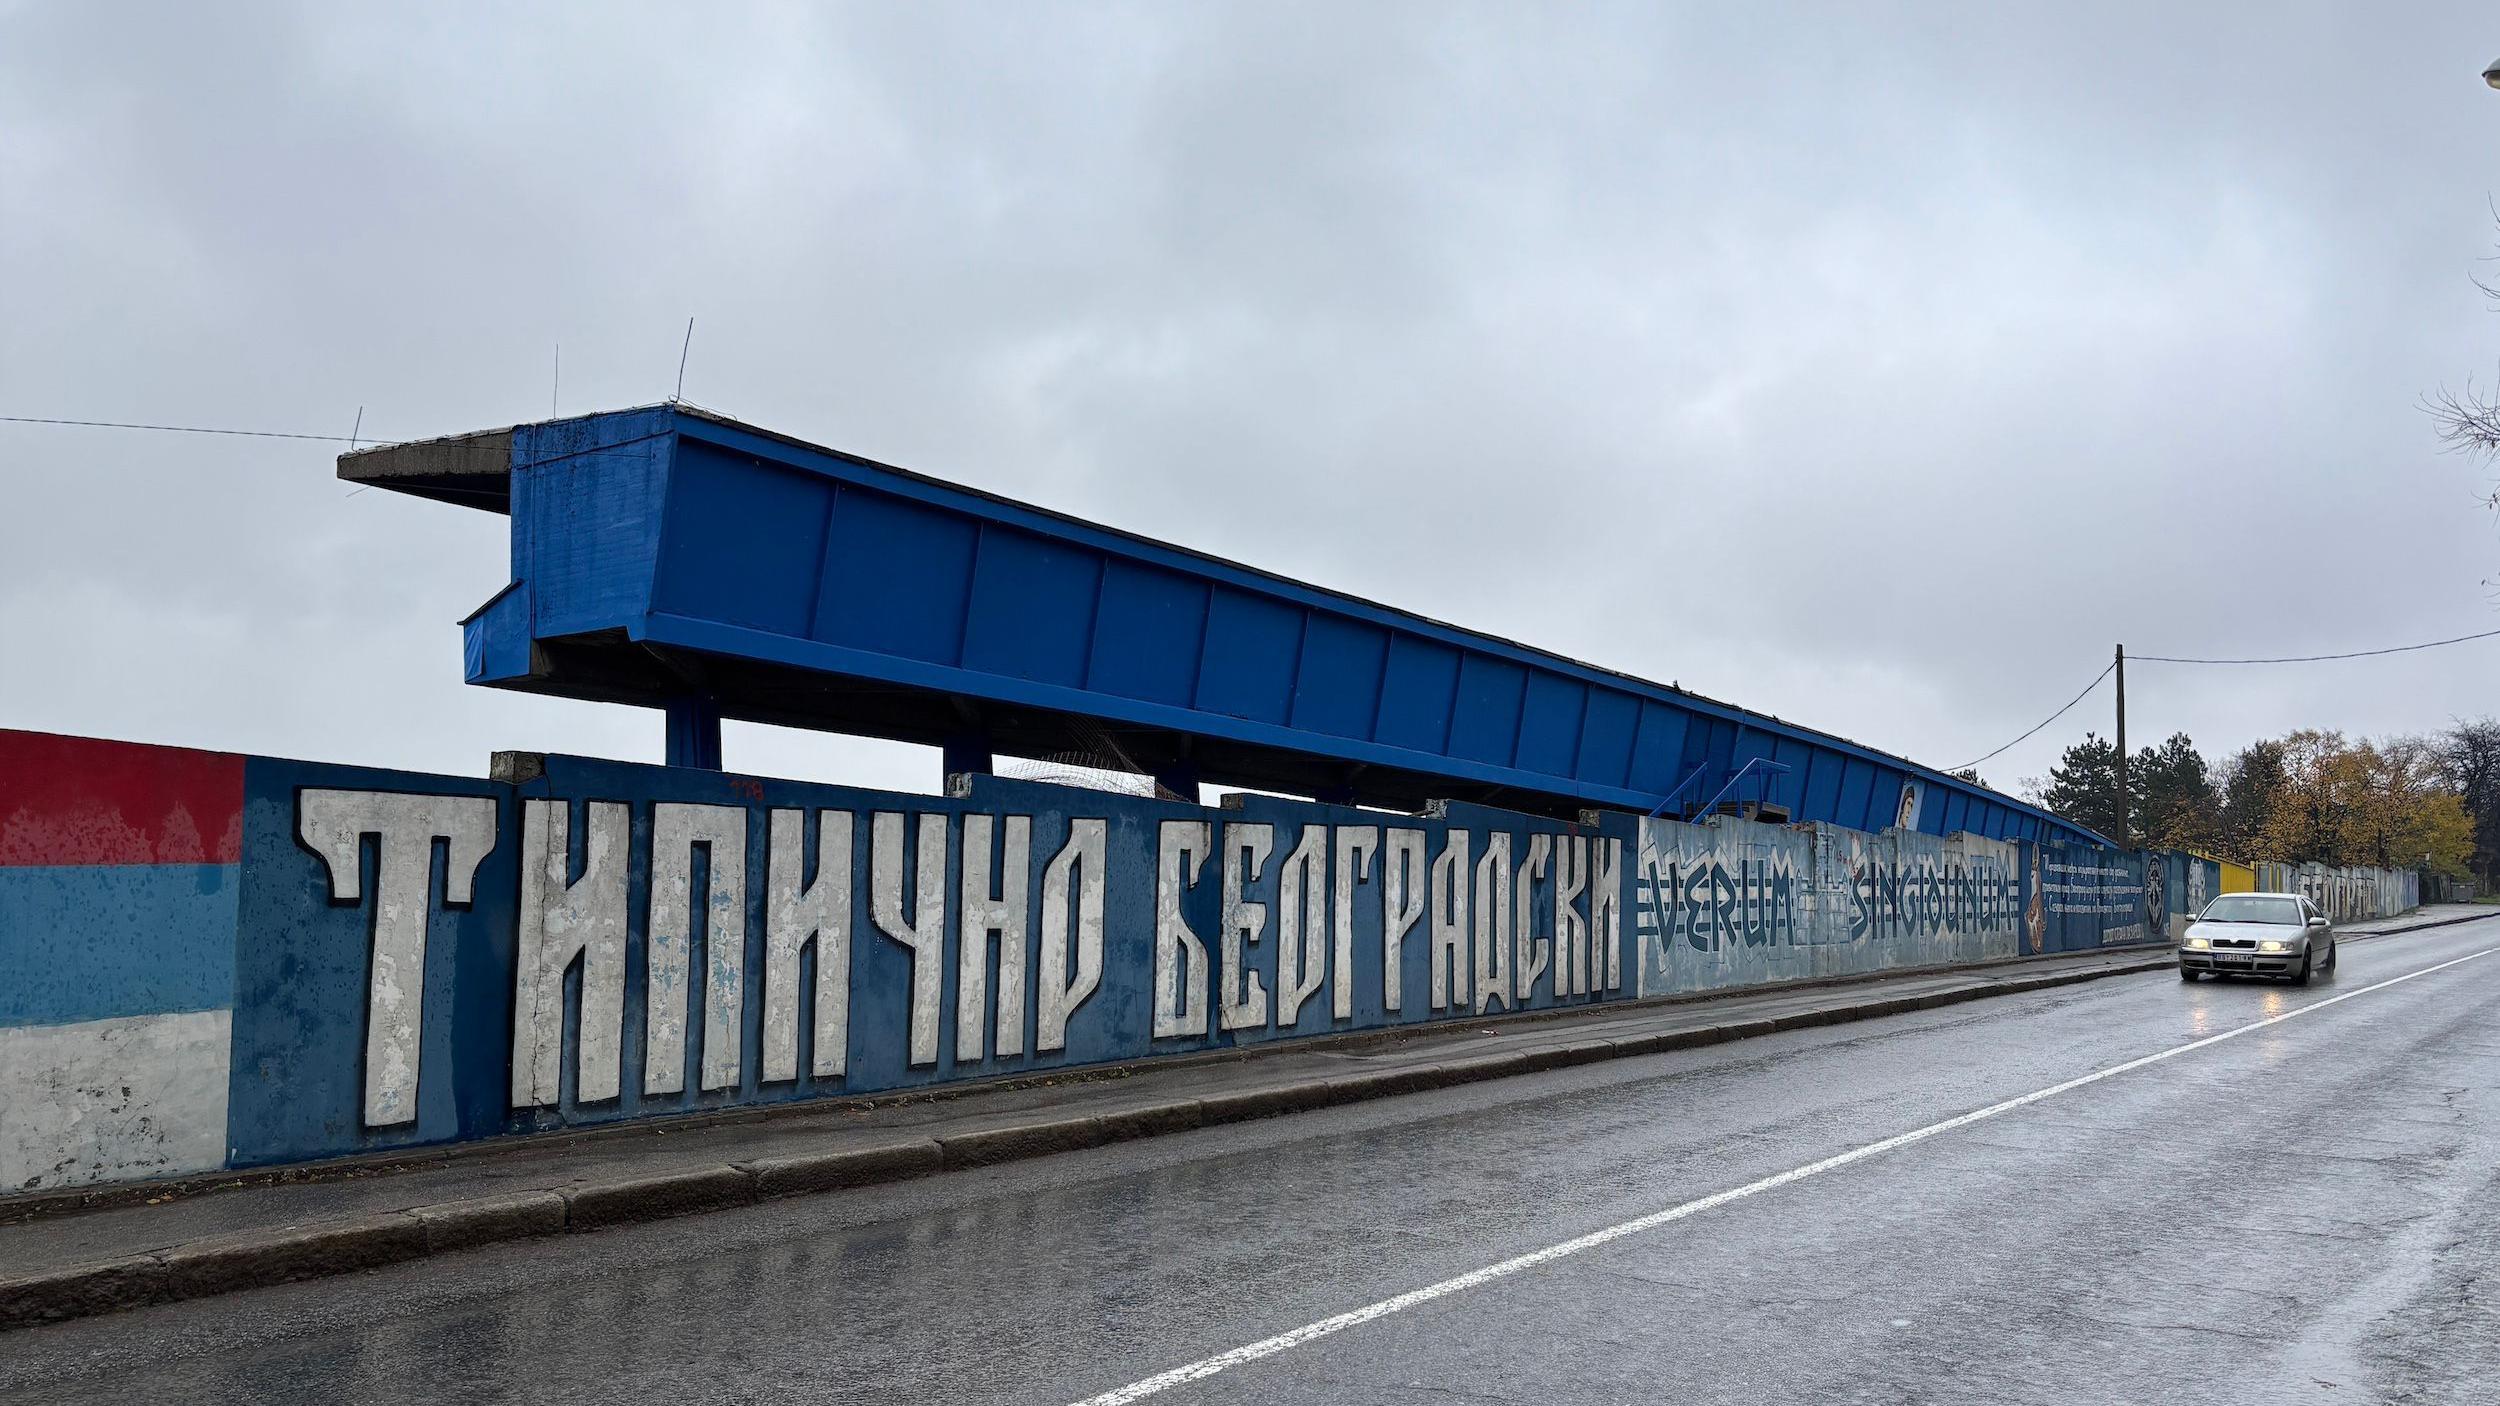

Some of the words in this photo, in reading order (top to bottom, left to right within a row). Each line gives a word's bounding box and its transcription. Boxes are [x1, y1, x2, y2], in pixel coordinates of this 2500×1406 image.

[297, 786, 1109, 1131] ТИПИЧНО
[1152, 819, 1623, 1041] БЕОГРАДСКИ
[1647, 857, 1796, 955] VERUM
[1849, 861, 2013, 942] SINGIDUNUM
